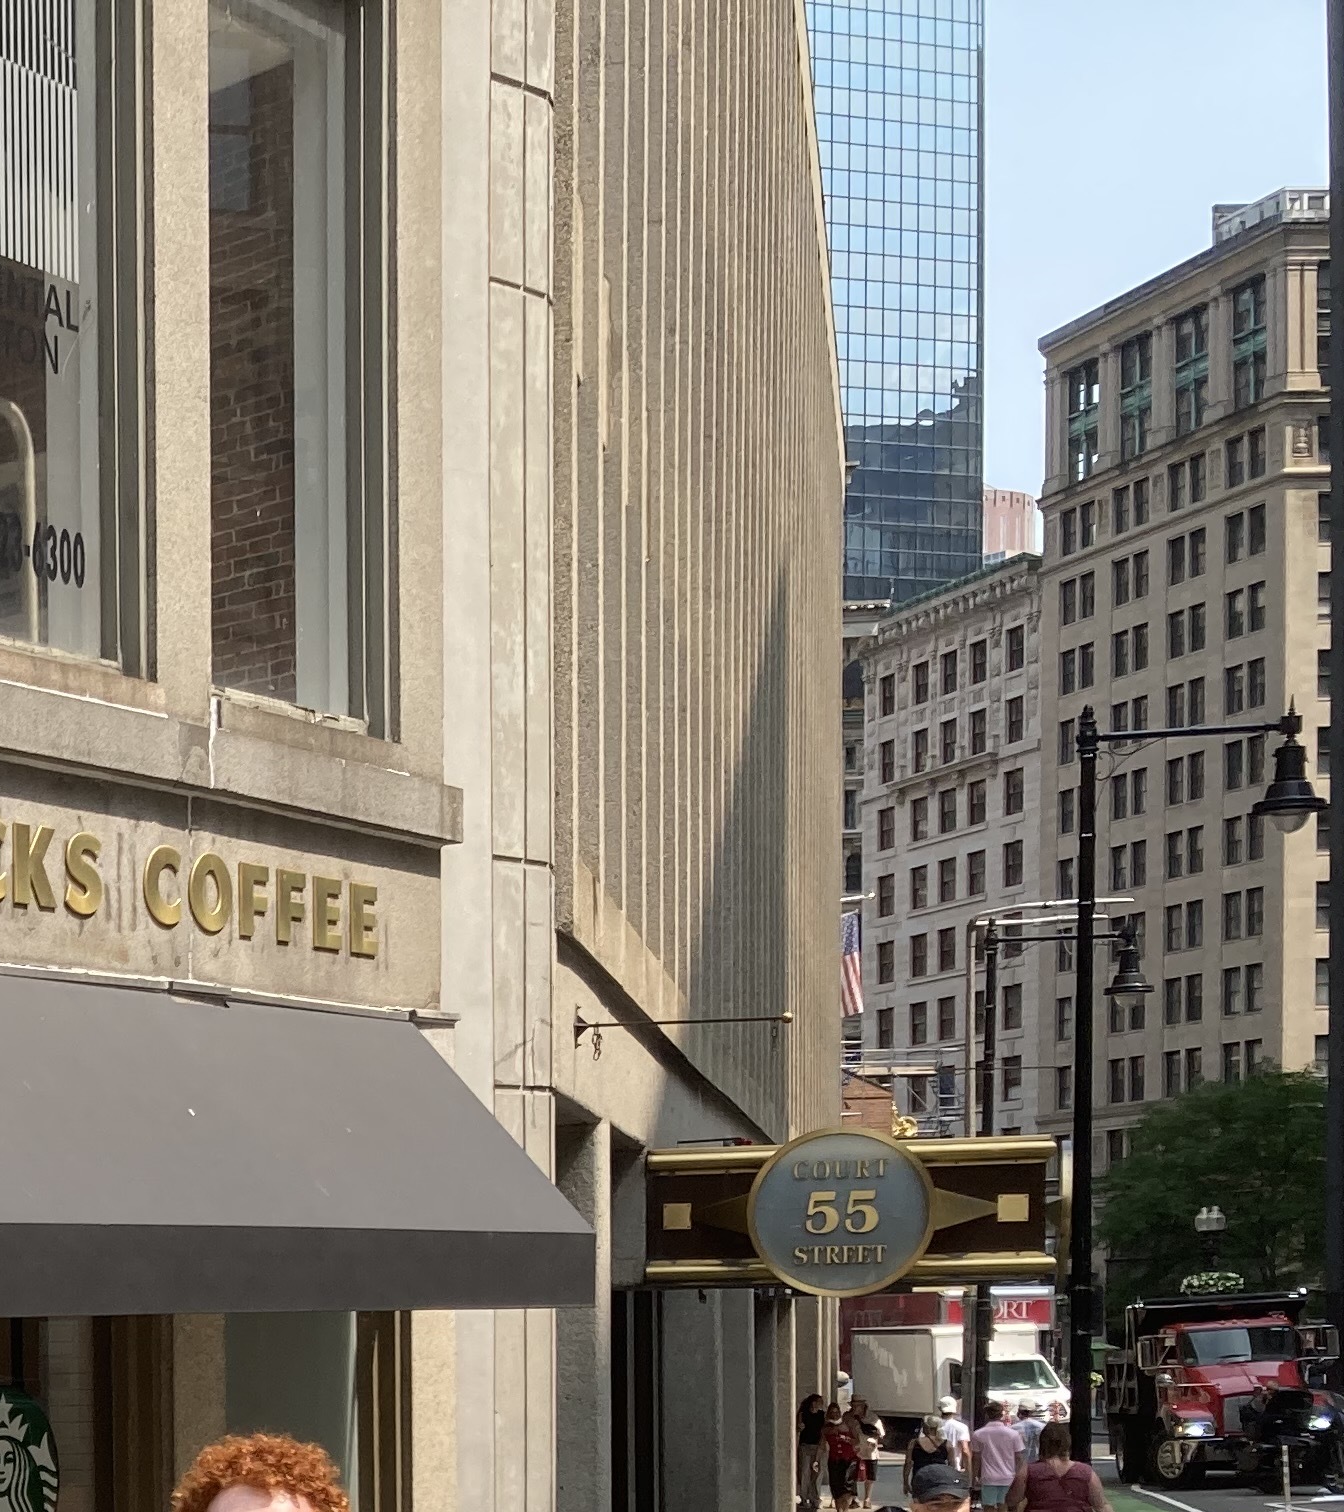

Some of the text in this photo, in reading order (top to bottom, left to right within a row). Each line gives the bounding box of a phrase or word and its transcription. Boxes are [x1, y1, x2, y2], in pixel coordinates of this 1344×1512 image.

[143, 843, 379, 958] COFFEE
[793, 1158, 889, 1181] COURT
[805, 1188, 880, 1235] 55
[793, 1244, 888, 1265] STREET
